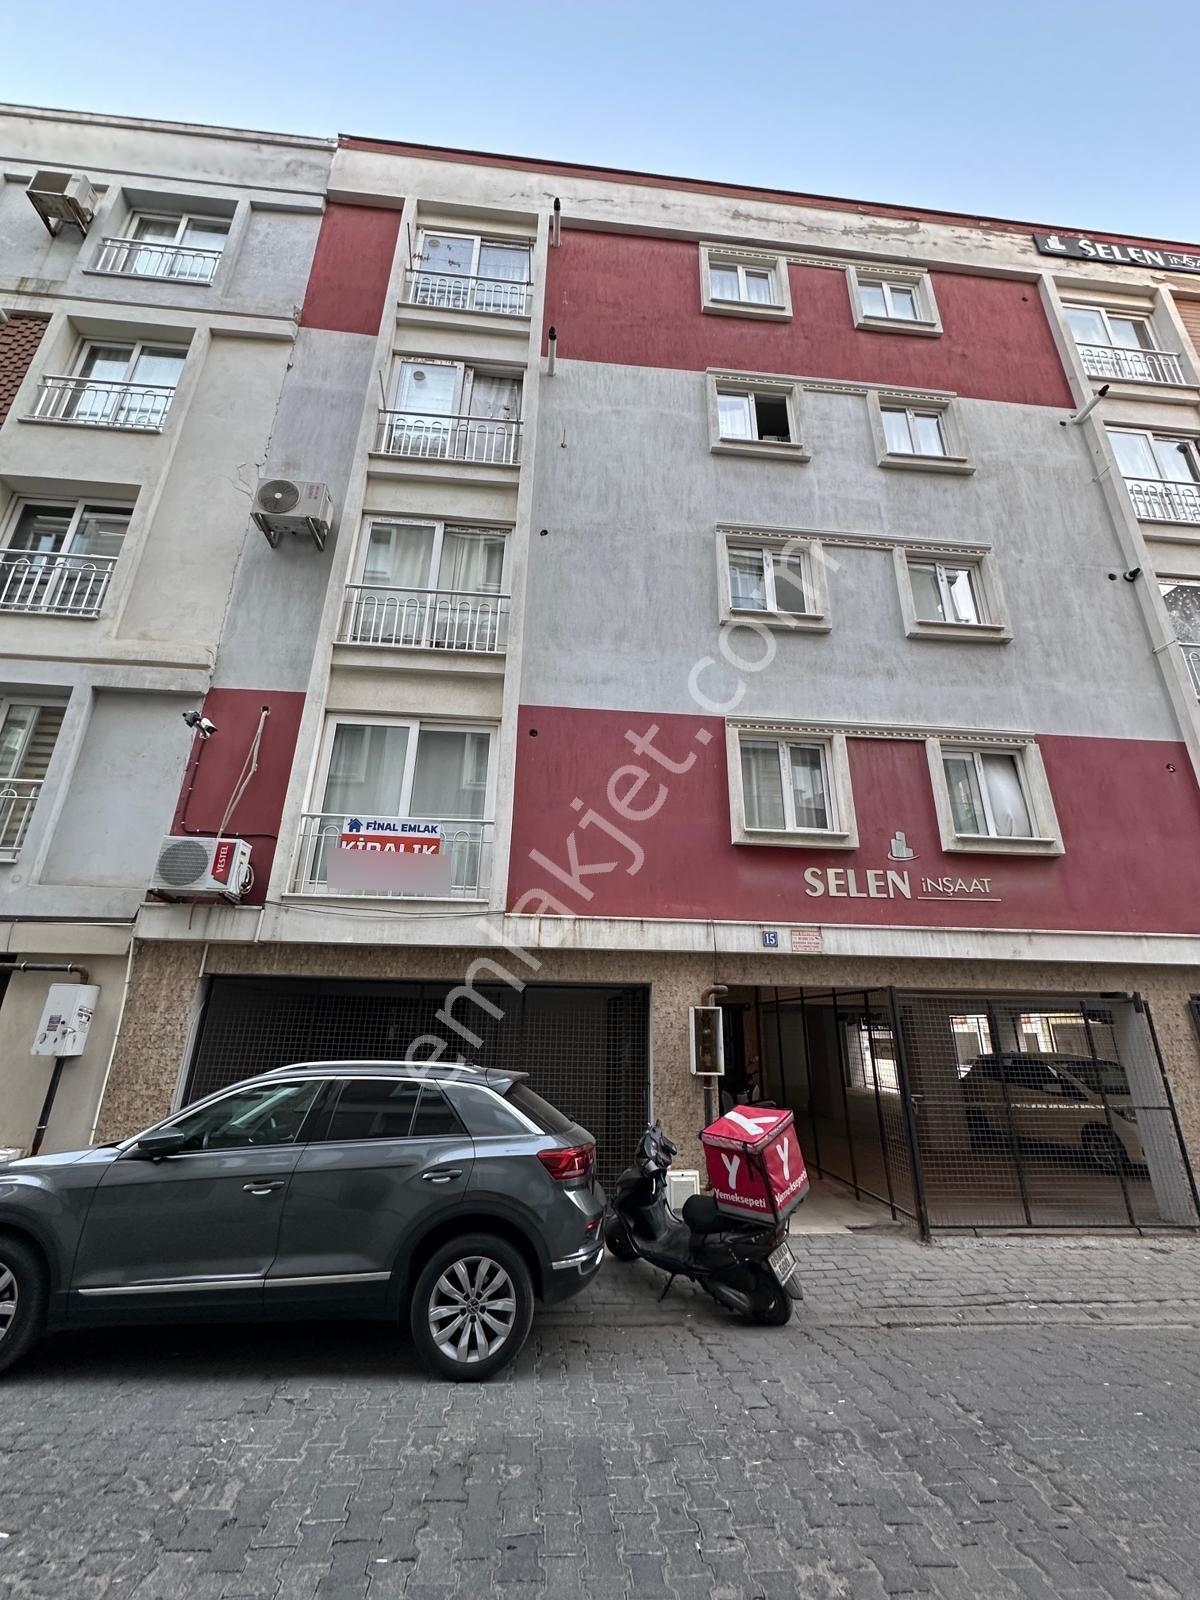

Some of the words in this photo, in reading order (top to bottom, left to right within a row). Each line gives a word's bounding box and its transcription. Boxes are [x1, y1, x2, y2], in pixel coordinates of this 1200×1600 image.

[1078, 239, 1165, 266] SELEN
[366, 820, 398, 832] FİNAL
[401, 823, 438, 834] EMLAK
[803, 867, 912, 899] SELEN
[765, 933, 776, 944] 15
[714, 1188, 767, 1209] Yemeksepeti
